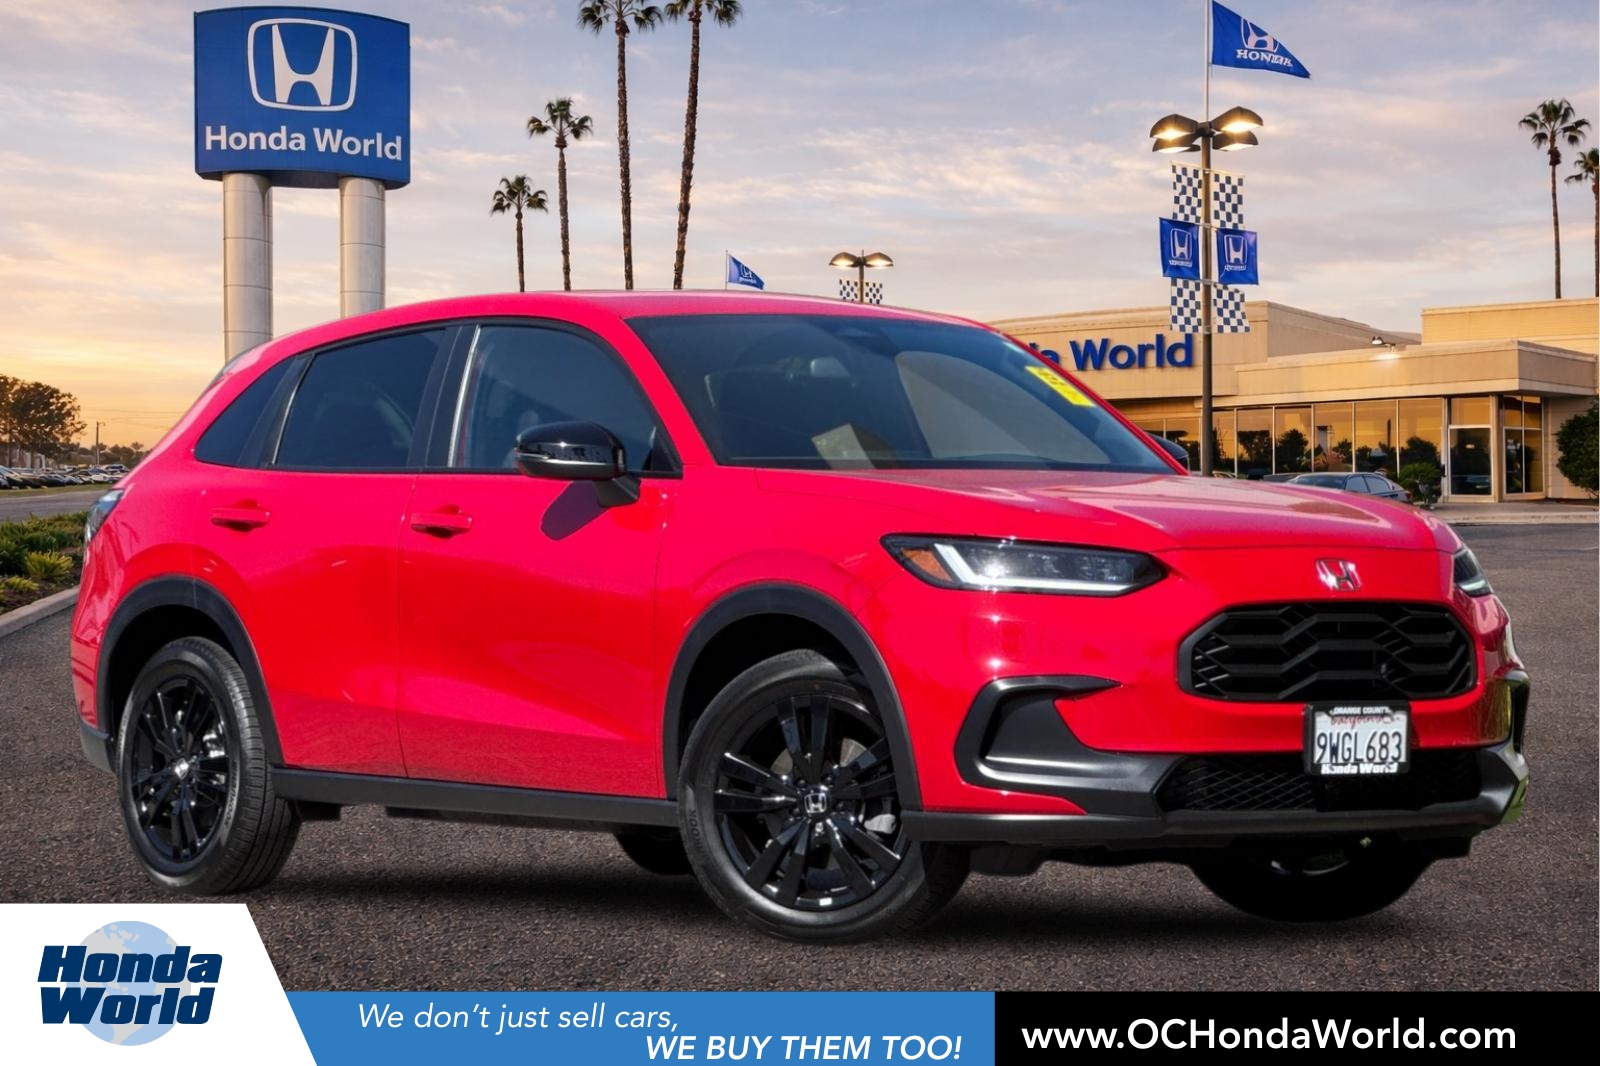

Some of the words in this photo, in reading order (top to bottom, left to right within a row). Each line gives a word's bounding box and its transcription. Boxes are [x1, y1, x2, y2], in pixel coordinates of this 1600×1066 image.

[205, 125, 306, 151] Honda
[312, 127, 402, 161] World
[1069, 333, 1193, 371] World
[1316, 731, 1402, 763] 9WGL683
